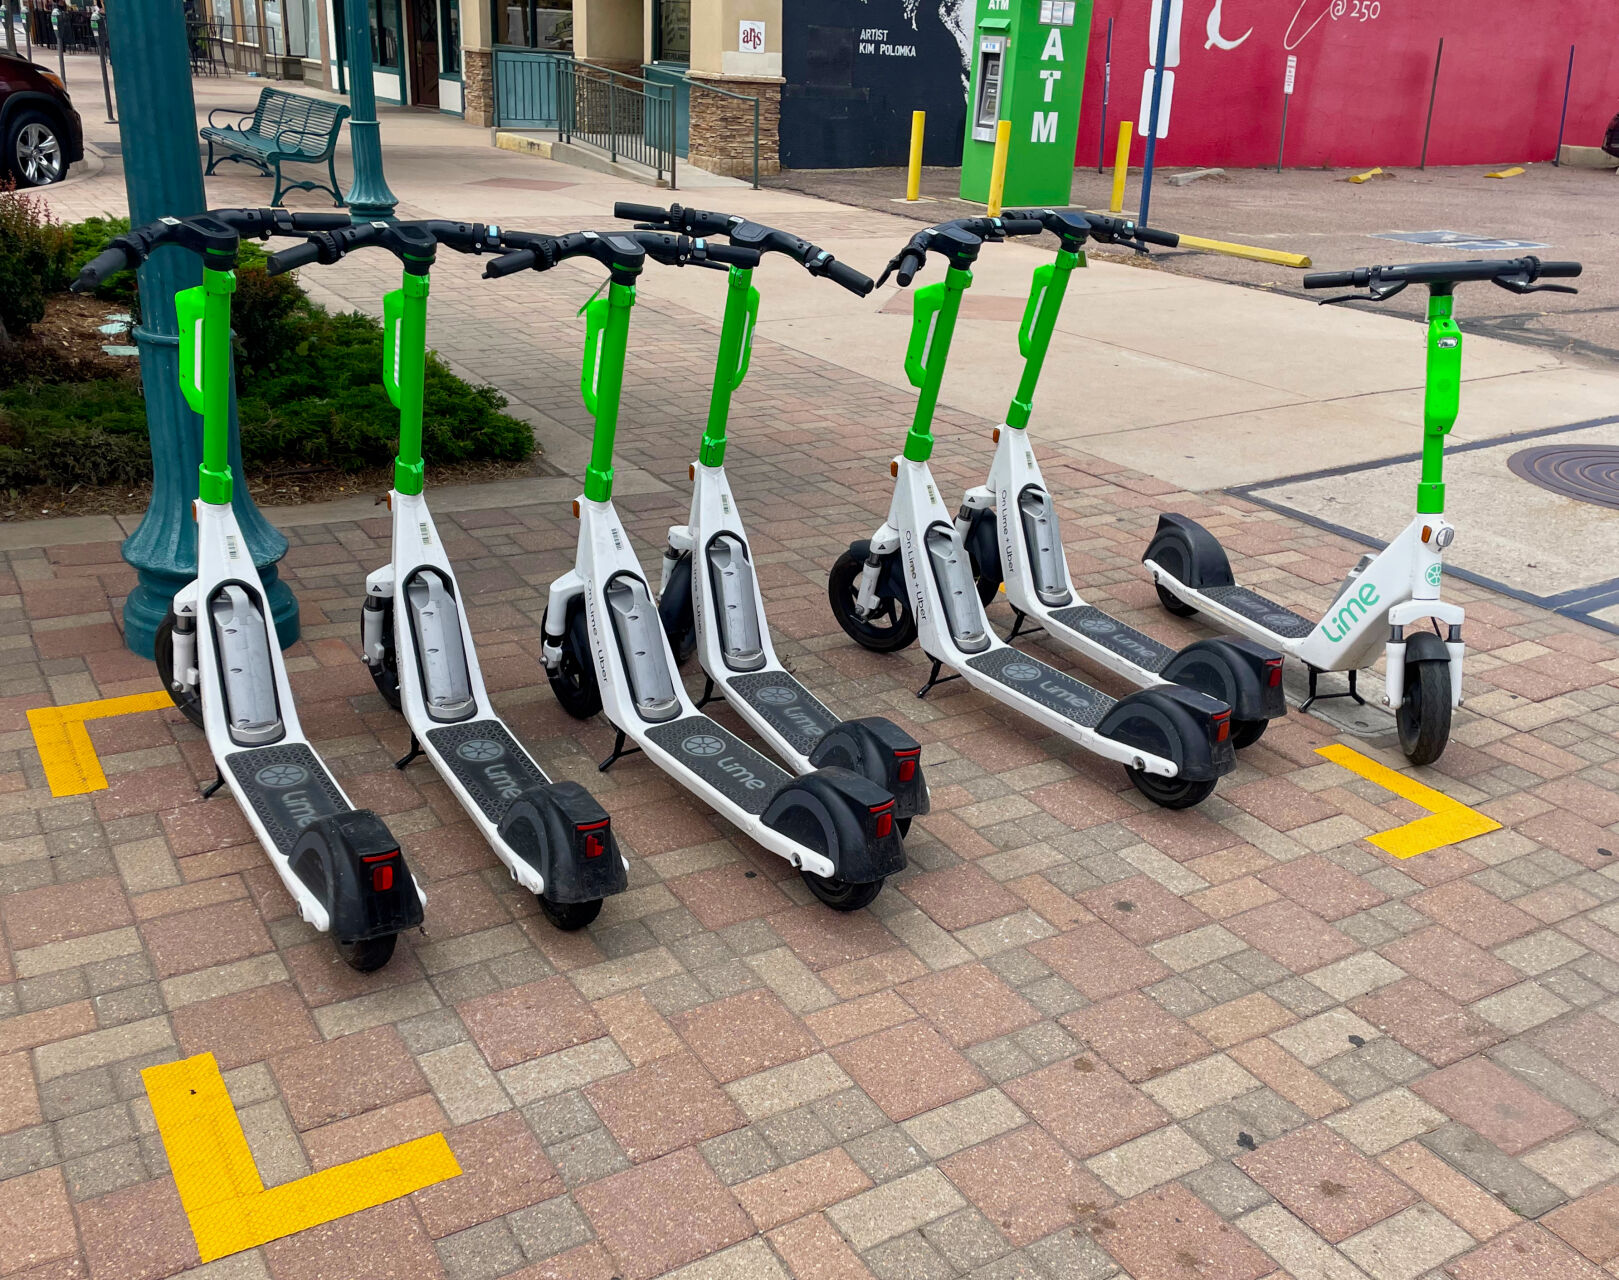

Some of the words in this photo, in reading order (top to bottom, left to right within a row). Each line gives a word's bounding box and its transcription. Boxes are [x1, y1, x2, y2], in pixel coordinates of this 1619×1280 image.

[1350, 1, 1381, 22] 250
[742, 27, 762, 50] arts
[860, 28, 889, 42] ARTIST
[859, 42, 875, 55] KIM
[879, 43, 917, 57] POLOMKA
[1005, 545, 1015, 573] Uber
[905, 530, 912, 549] On
[916, 591, 927, 621] Uber
[1320, 582, 1381, 643] Lime
[597, 649, 608, 682] Uber
[1040, 680, 1090, 708] Lime
[717, 756, 766, 790] Lime
